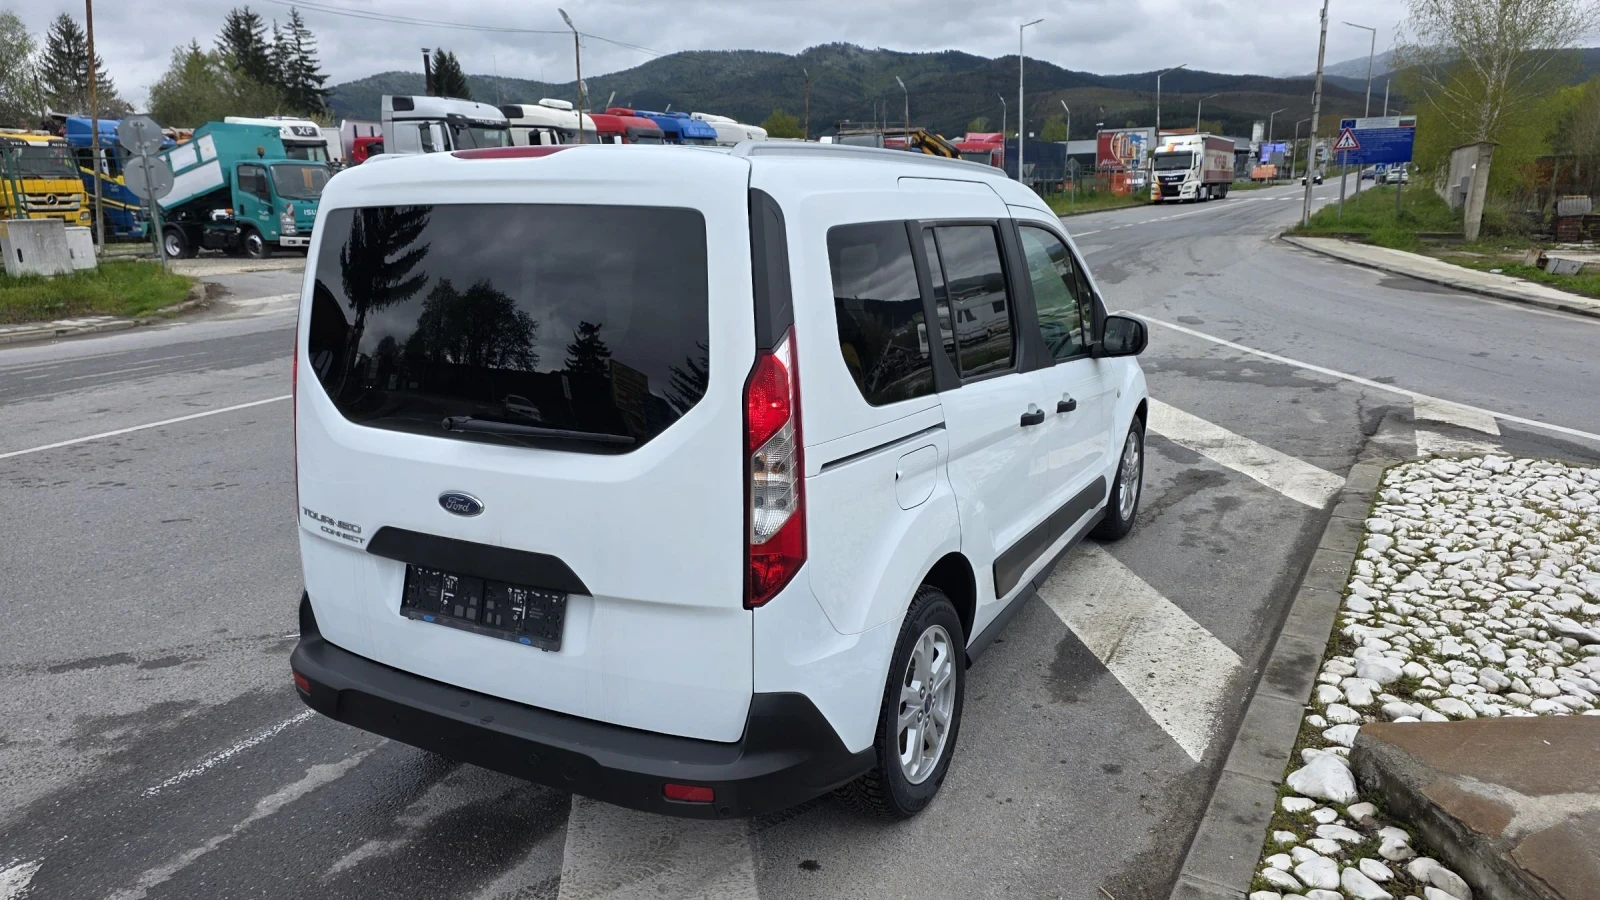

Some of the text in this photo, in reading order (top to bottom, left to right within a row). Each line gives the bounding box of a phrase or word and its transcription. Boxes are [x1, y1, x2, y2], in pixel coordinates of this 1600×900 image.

[297, 127, 313, 135] XF
[445, 496, 470, 512] Ford
[302, 506, 362, 534] TOURNEO
[320, 525, 365, 544] CONNECT
